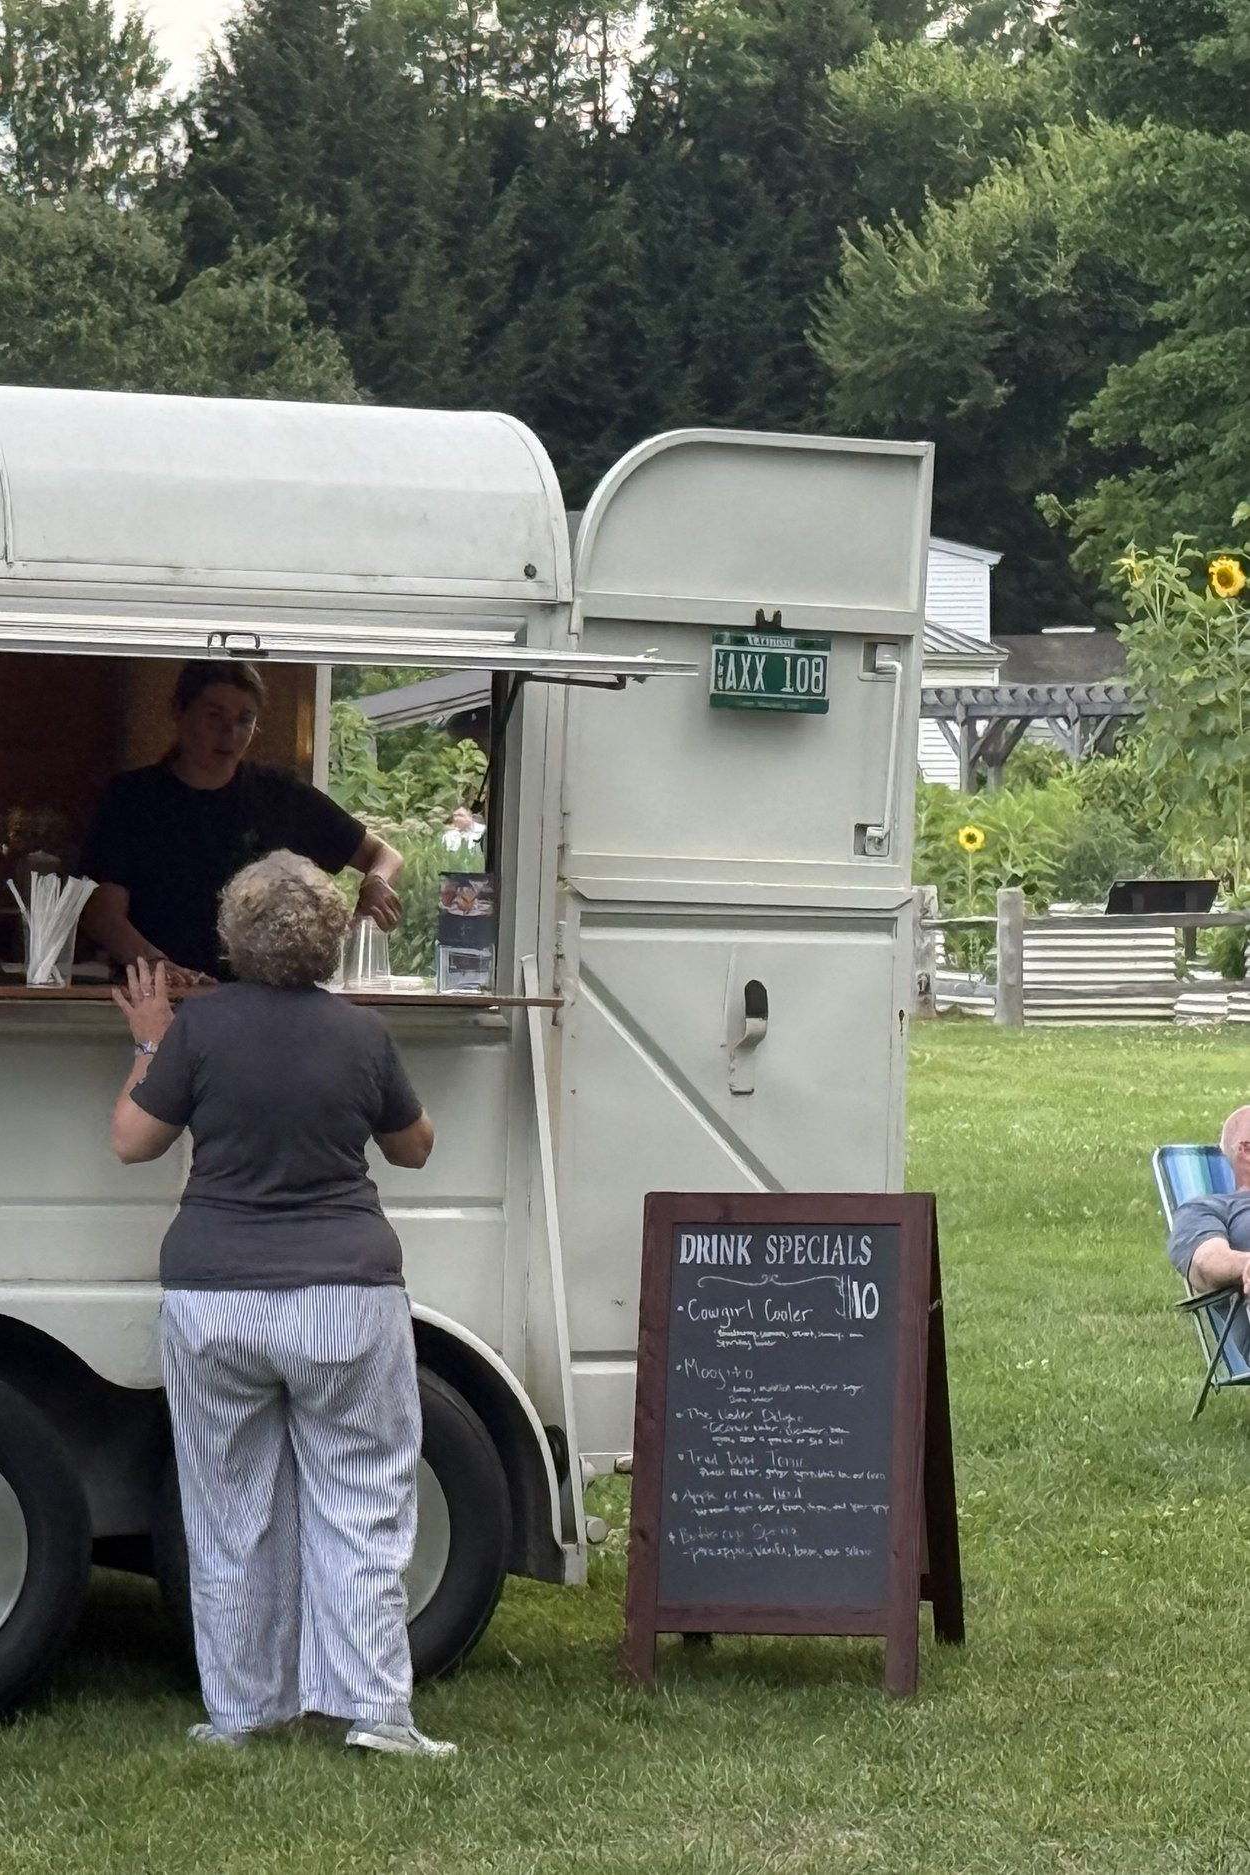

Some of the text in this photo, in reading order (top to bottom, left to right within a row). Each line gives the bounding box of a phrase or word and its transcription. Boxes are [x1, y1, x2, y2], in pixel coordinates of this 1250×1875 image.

[724, 652, 768, 692] AXX
[779, 655, 824, 694] 108
[679, 1233, 873, 1266] DRINK SPECIALS
[686, 1298, 814, 1329] Cowgirl Cooler
